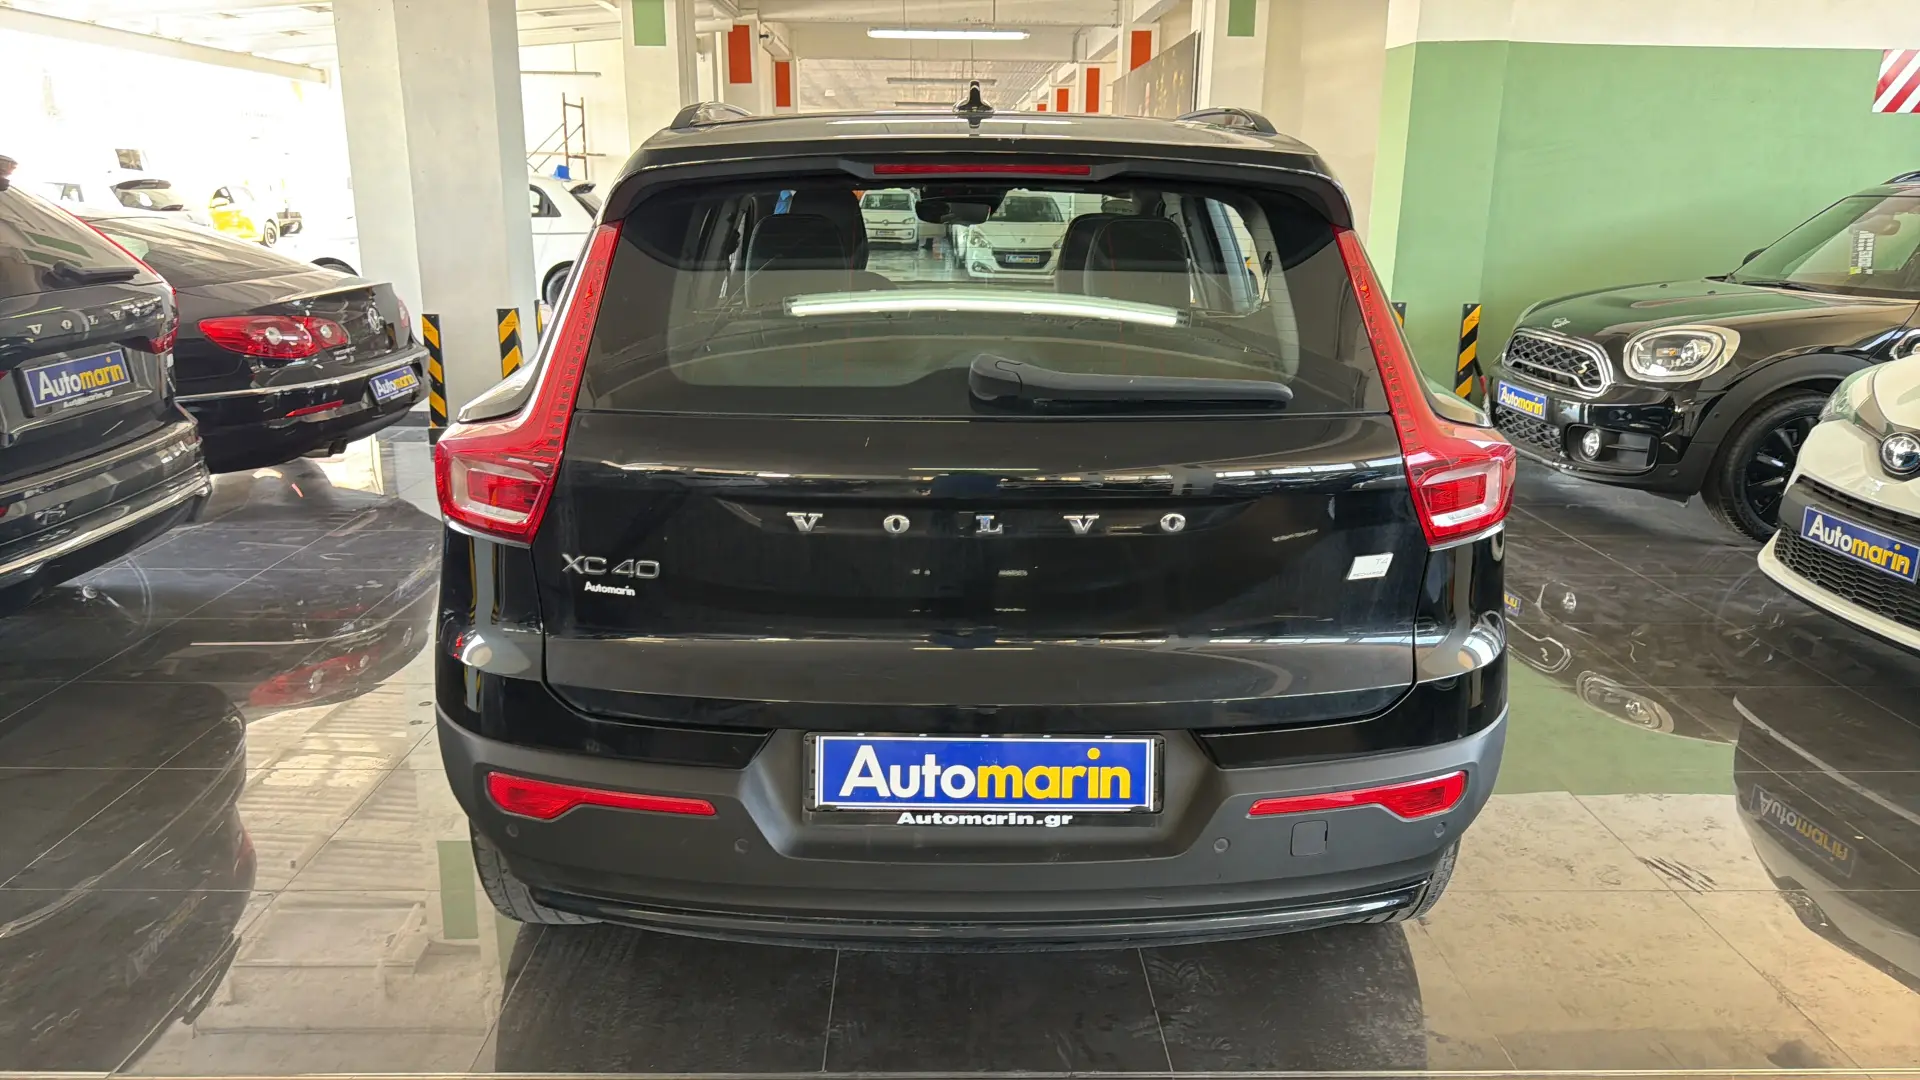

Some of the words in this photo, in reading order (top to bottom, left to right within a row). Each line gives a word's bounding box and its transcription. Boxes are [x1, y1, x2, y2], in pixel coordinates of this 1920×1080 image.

[39, 356, 125, 401] Automarin
[1500, 385, 1544, 416] Automarin
[786, 511, 1187, 534] VOLVO
[1807, 514, 1911, 575] Automarin
[584, 581, 636, 596] Automarin
[838, 744, 1131, 800] Automarin
[896, 812, 1074, 827] Automarin.gr
